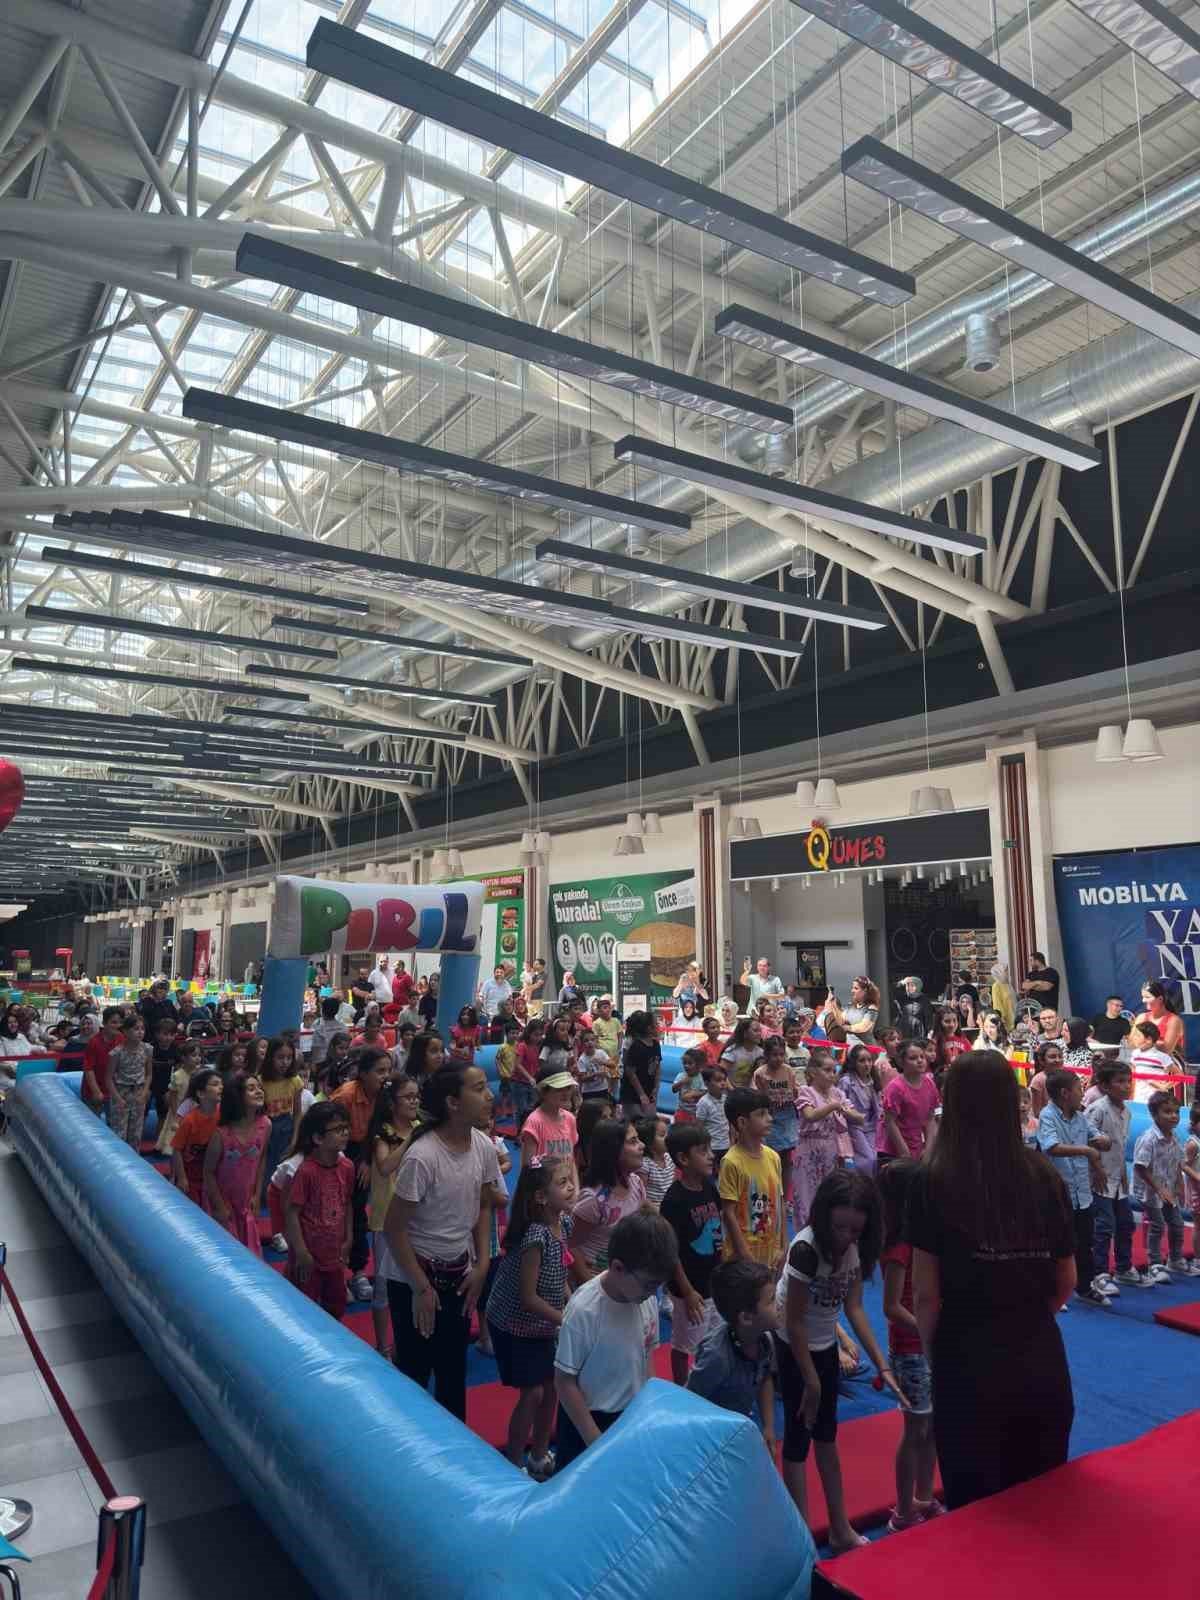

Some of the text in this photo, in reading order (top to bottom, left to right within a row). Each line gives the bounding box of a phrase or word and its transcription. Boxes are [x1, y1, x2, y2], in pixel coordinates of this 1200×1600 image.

[657, 892, 678, 909] önce
[1079, 881, 1188, 905] MOBİLYA
[555, 901, 602, 923] burada!
[562, 938, 570, 956] 8
[579, 937, 594, 954] 10
